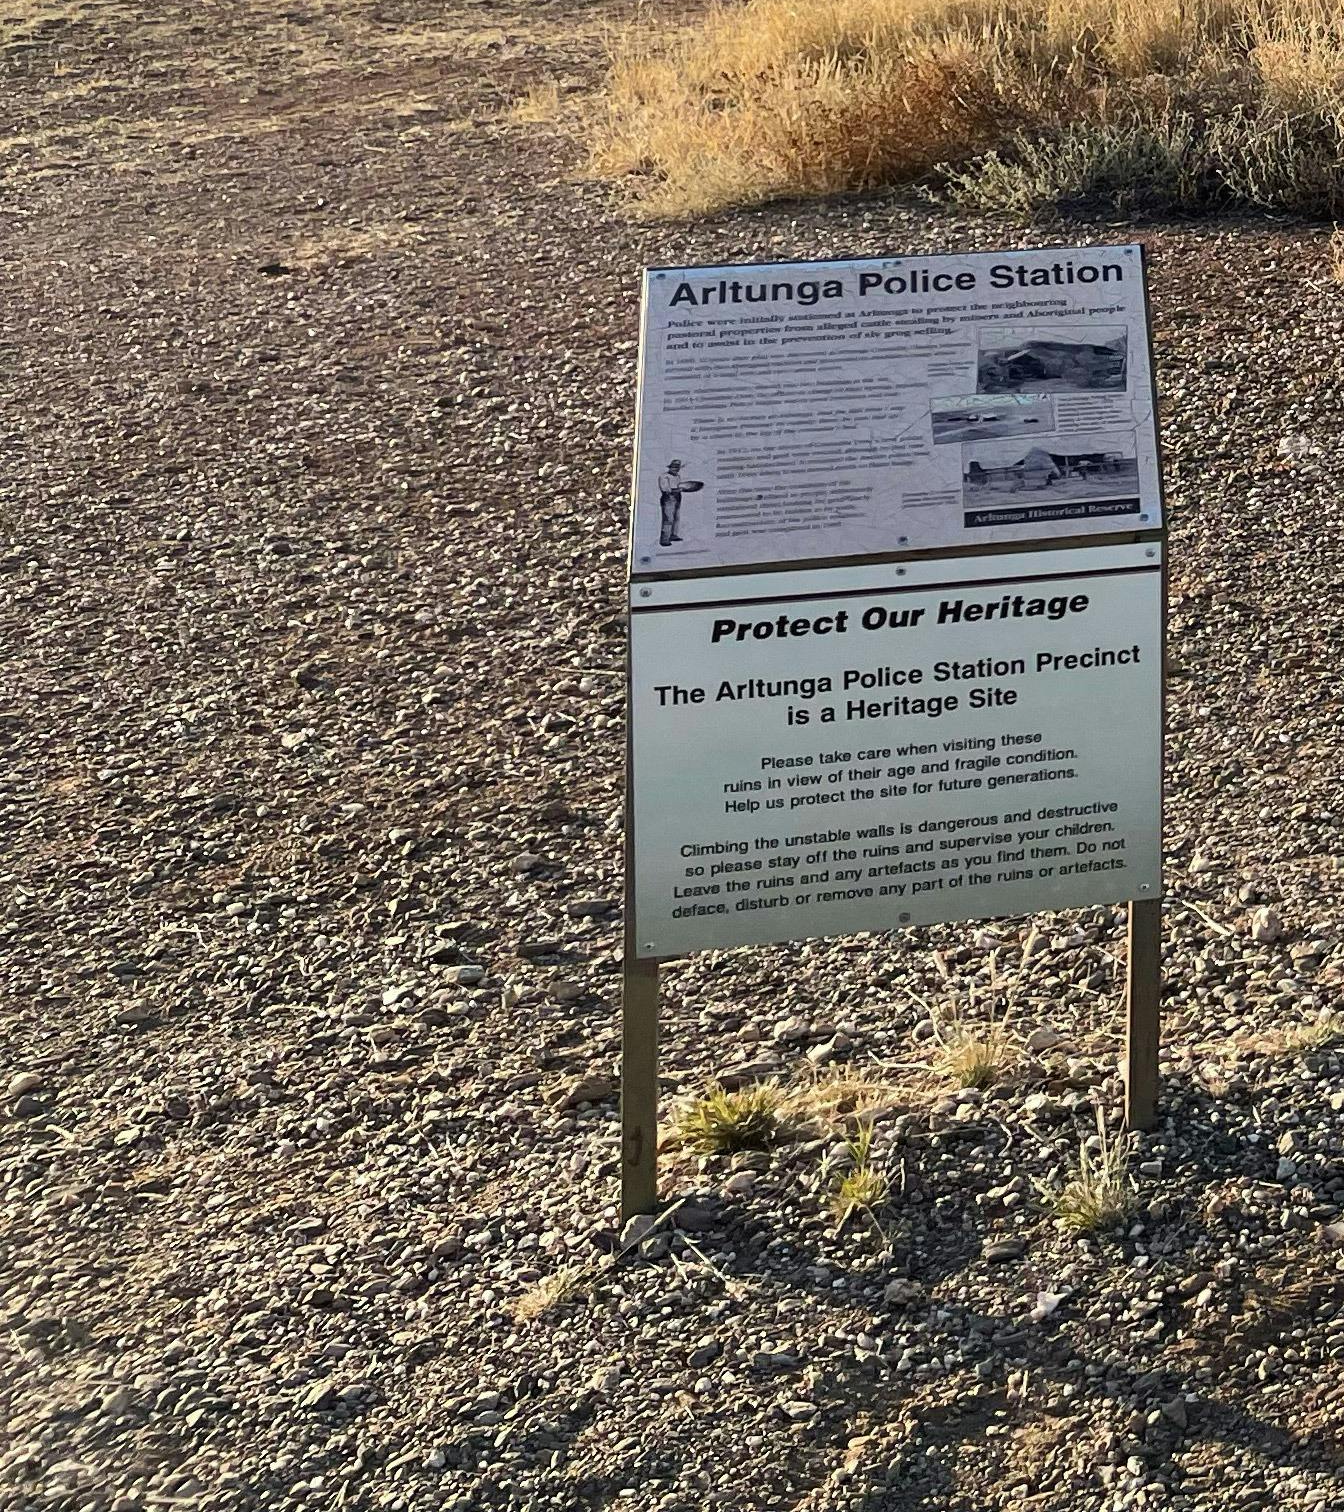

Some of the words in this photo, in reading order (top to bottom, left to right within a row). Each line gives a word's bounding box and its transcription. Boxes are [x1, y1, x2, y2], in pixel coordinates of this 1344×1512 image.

[669, 280, 843, 307] Arltunga
[859, 269, 976, 296] Police
[990, 261, 1123, 289] Station
[667, 320, 704, 329] Police
[1029, 505, 1085, 518] Historical
[1088, 504, 1133, 513] Reserve
[711, 610, 849, 643] Protect
[862, 606, 926, 630] Our
[937, 595, 1089, 624] Heritage
[654, 685, 705, 706] The
[715, 677, 832, 702] Arltunga
[844, 666, 923, 690] Police
[934, 657, 1025, 682] Station
[1036, 645, 1140, 672] Precinct
[788, 706, 810, 726] is
[820, 707, 836, 723] a
[847, 696, 959, 720] Heritage
[969, 687, 1017, 708] Site
[724, 780, 762, 793] ruins
[768, 777, 781, 789] in
[787, 774, 823, 787] view
[828, 770, 843, 783] of
[848, 767, 882, 781] their
[887, 766, 915, 780] age
[921, 759, 949, 774] and
[955, 755, 1001, 771] fragile
[1006, 749, 1078, 765] condition.
[761, 756, 813, 770] Please
[819, 750, 852, 764] take
[857, 748, 891, 761] care
[896, 743, 938, 756] when
[943, 737, 996, 752] visiting
[1001, 733, 1042, 746] these
[725, 799, 760, 814] Help
[766, 798, 784, 809] us
[790, 791, 845, 810] protect
[850, 788, 874, 801] the
[880, 785, 907, 798] site
[913, 782, 933, 794] for
[938, 778, 982, 792] future
[987, 769, 1078, 790] generations.
[680, 840, 748, 857] Climbing
[754, 837, 779, 850] the
[785, 829, 851, 847] unstable
[856, 825, 895, 839] walls
[900, 822, 913, 834] is
[918, 815, 998, 833] dangerous
[1004, 808, 1032, 824] and
[1037, 801, 1118, 820] destructive
[685, 866, 704, 877] so
[710, 860, 762, 877] please
[768, 856, 800, 869] stay
[806, 850, 827, 864] off
[832, 849, 857, 861] the
[863, 845, 900, 858] ruins
[905, 839, 933, 854] and
[939, 832, 1012, 851] supervise
[1017, 828, 1050, 845] your
[1055, 821, 1115, 837] children.
[672, 904, 729, 919] deface,
[735, 894, 789, 912] disturb
[795, 894, 811, 905] or
[816, 887, 873, 903] remove
[879, 884, 907, 897] any
[912, 878, 944, 895] part
[948, 874, 963, 888] of
[968, 873, 992, 885] the
[997, 869, 1033, 882] ruins
[1039, 867, 1054, 878] or
[1059, 858, 1127, 875] artefacts.
[674, 884, 720, 899] Leave
[726, 880, 751, 892] the
[756, 876, 794, 890] ruins
[800, 870, 829, 885] and
[835, 868, 862, 882] any
[868, 860, 936, 877] artefacts
[941, 858, 959, 869] as
[964, 855, 992, 870] you
[997, 848, 1025, 863] find
[1030, 846, 1070, 859] them.
[1076, 841, 1097, 854] Do
[1102, 838, 1126, 851] not
